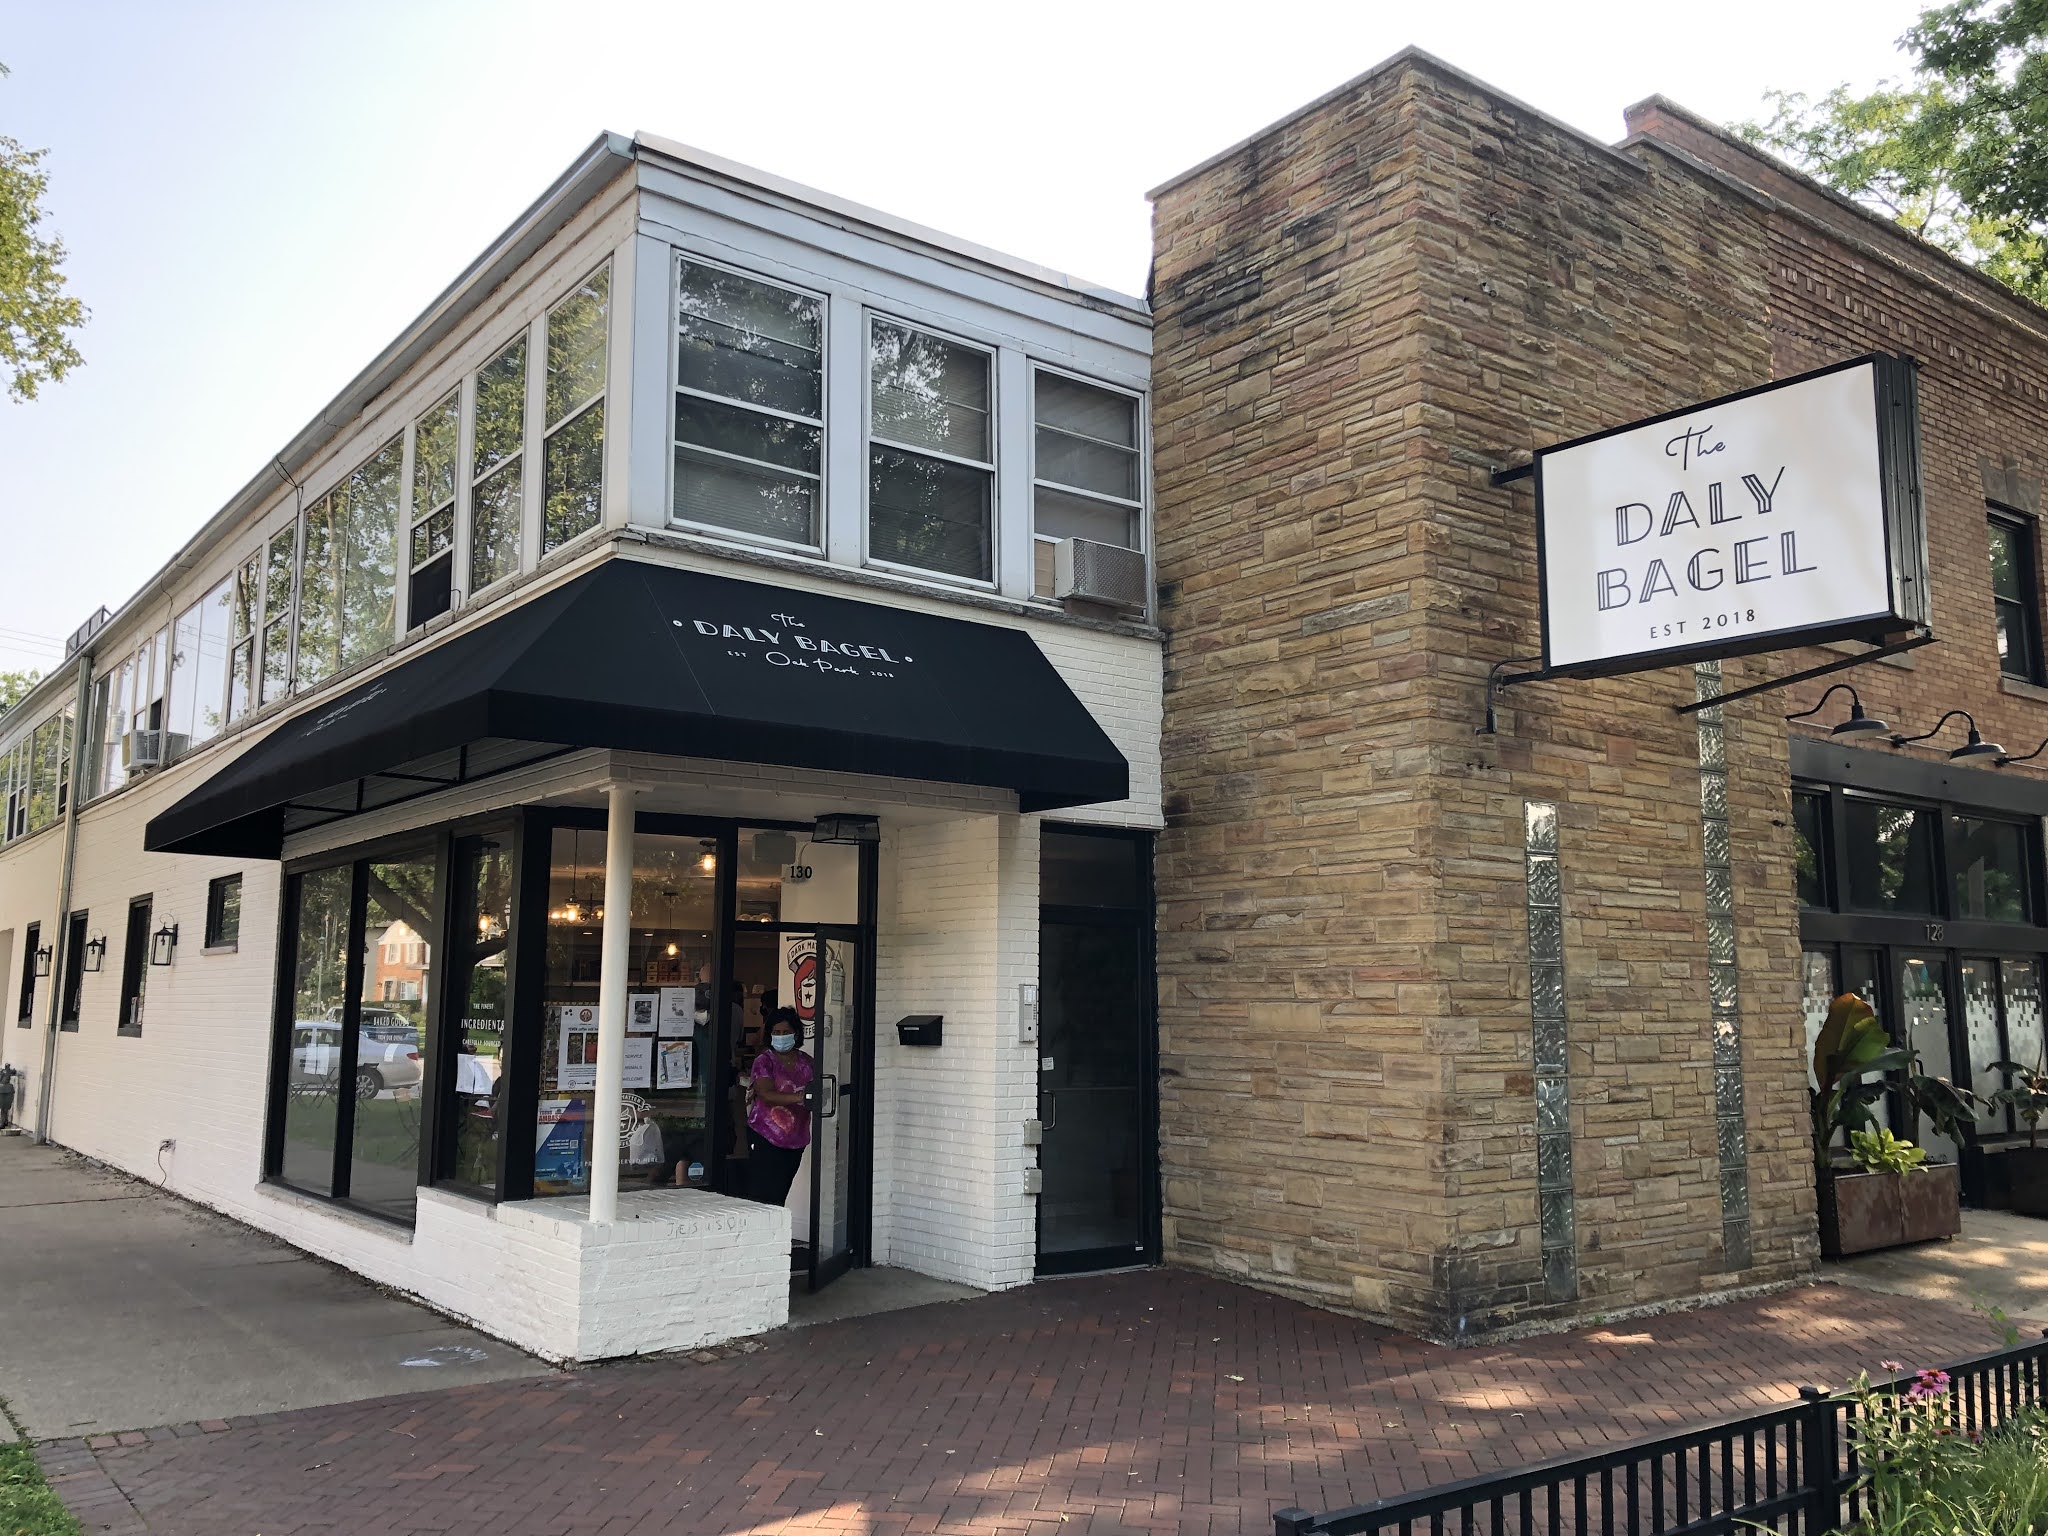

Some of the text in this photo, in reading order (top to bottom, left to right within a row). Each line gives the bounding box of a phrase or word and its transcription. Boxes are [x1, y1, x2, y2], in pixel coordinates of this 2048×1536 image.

[1665, 425, 1726, 471] The
[1615, 466, 1785, 546] DALY
[1597, 530, 1817, 611] BAGEL
[770, 612, 805, 628] The
[1650, 608, 1756, 639] EST 2018
[693, 620, 900, 663] DALY BAGEL
[727, 650, 747, 658] EST
[765, 651, 809, 668] Oak
[813, 657, 859, 675] Park
[790, 865, 813, 879] 130
[1925, 923, 1944, 941] 128
[790, 943, 806, 959] DARK
[460, 1018, 505, 1031] INGREDIENTS
